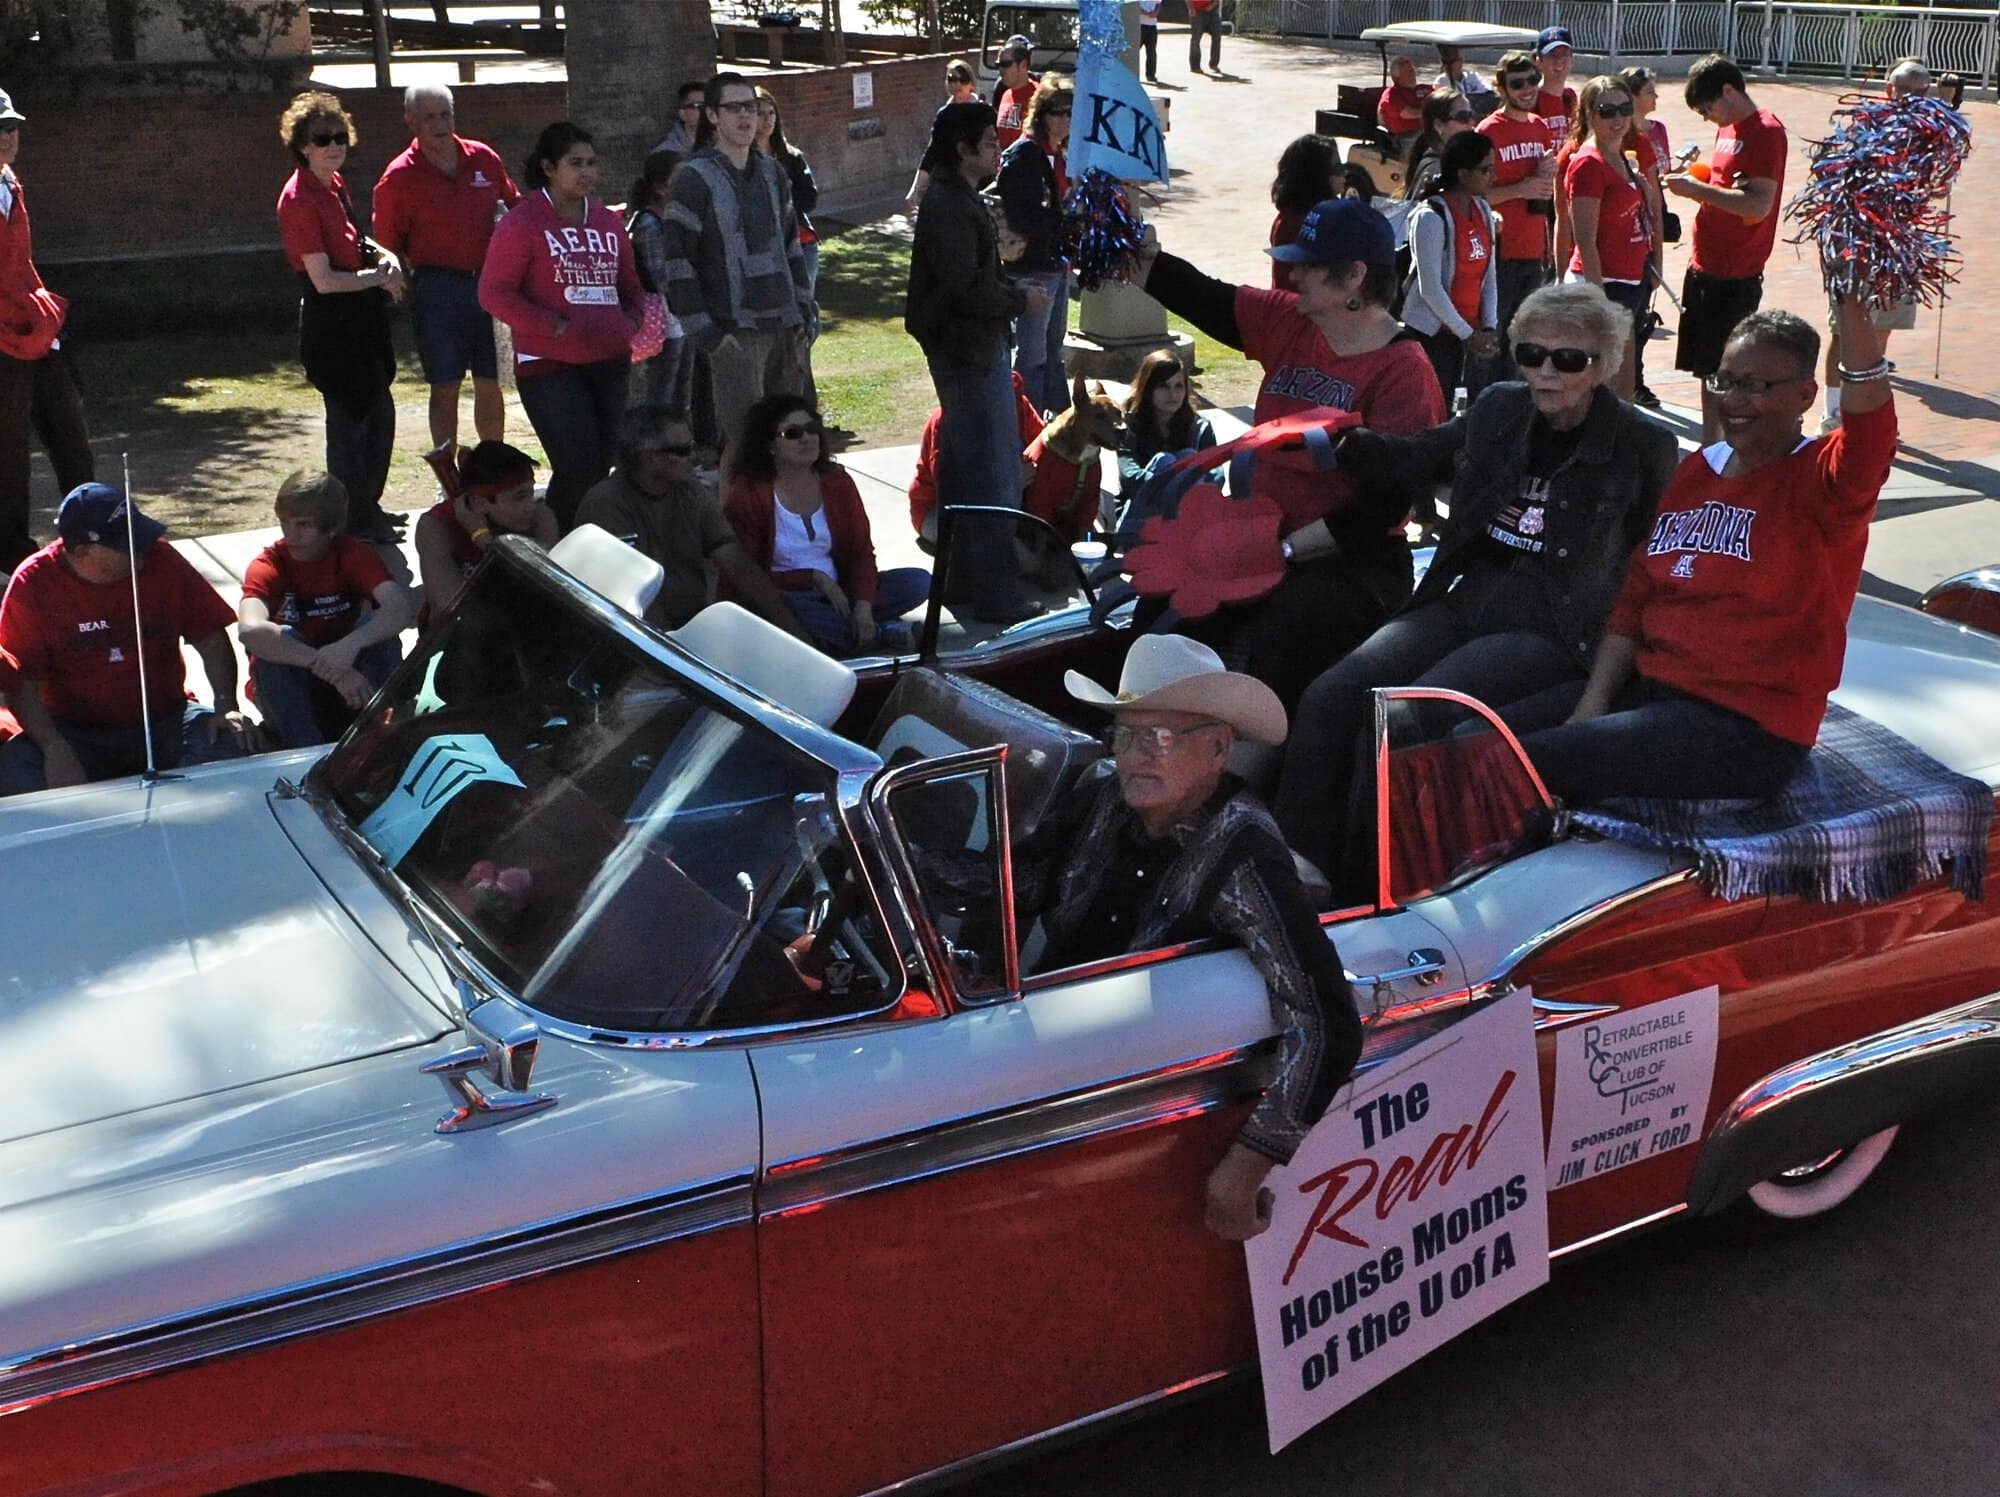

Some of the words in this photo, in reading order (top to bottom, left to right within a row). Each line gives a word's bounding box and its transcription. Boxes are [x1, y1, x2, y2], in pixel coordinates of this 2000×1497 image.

[544, 227, 619, 257] AERO
[78, 619, 112, 633] BEAR
[1648, 1060, 1667, 1075] OF
[1353, 1081, 1430, 1150] The
[1571, 1117, 1651, 1152] SPONSORED
[1670, 1104, 1689, 1119] BY
[1281, 1069, 1517, 1286] Real
[1556, 1157, 1586, 1186] JIM
[1593, 1138, 1641, 1173] CLICK
[1650, 1123, 1692, 1153] FORD
[1279, 1246, 1405, 1349] House
[1411, 1173, 1528, 1268] Moms
[1301, 1333, 1340, 1392] of
[1346, 1299, 1410, 1363] the
[1418, 1270, 1444, 1319] U
[1450, 1243, 1487, 1300] of
[1491, 1231, 1517, 1279] A
